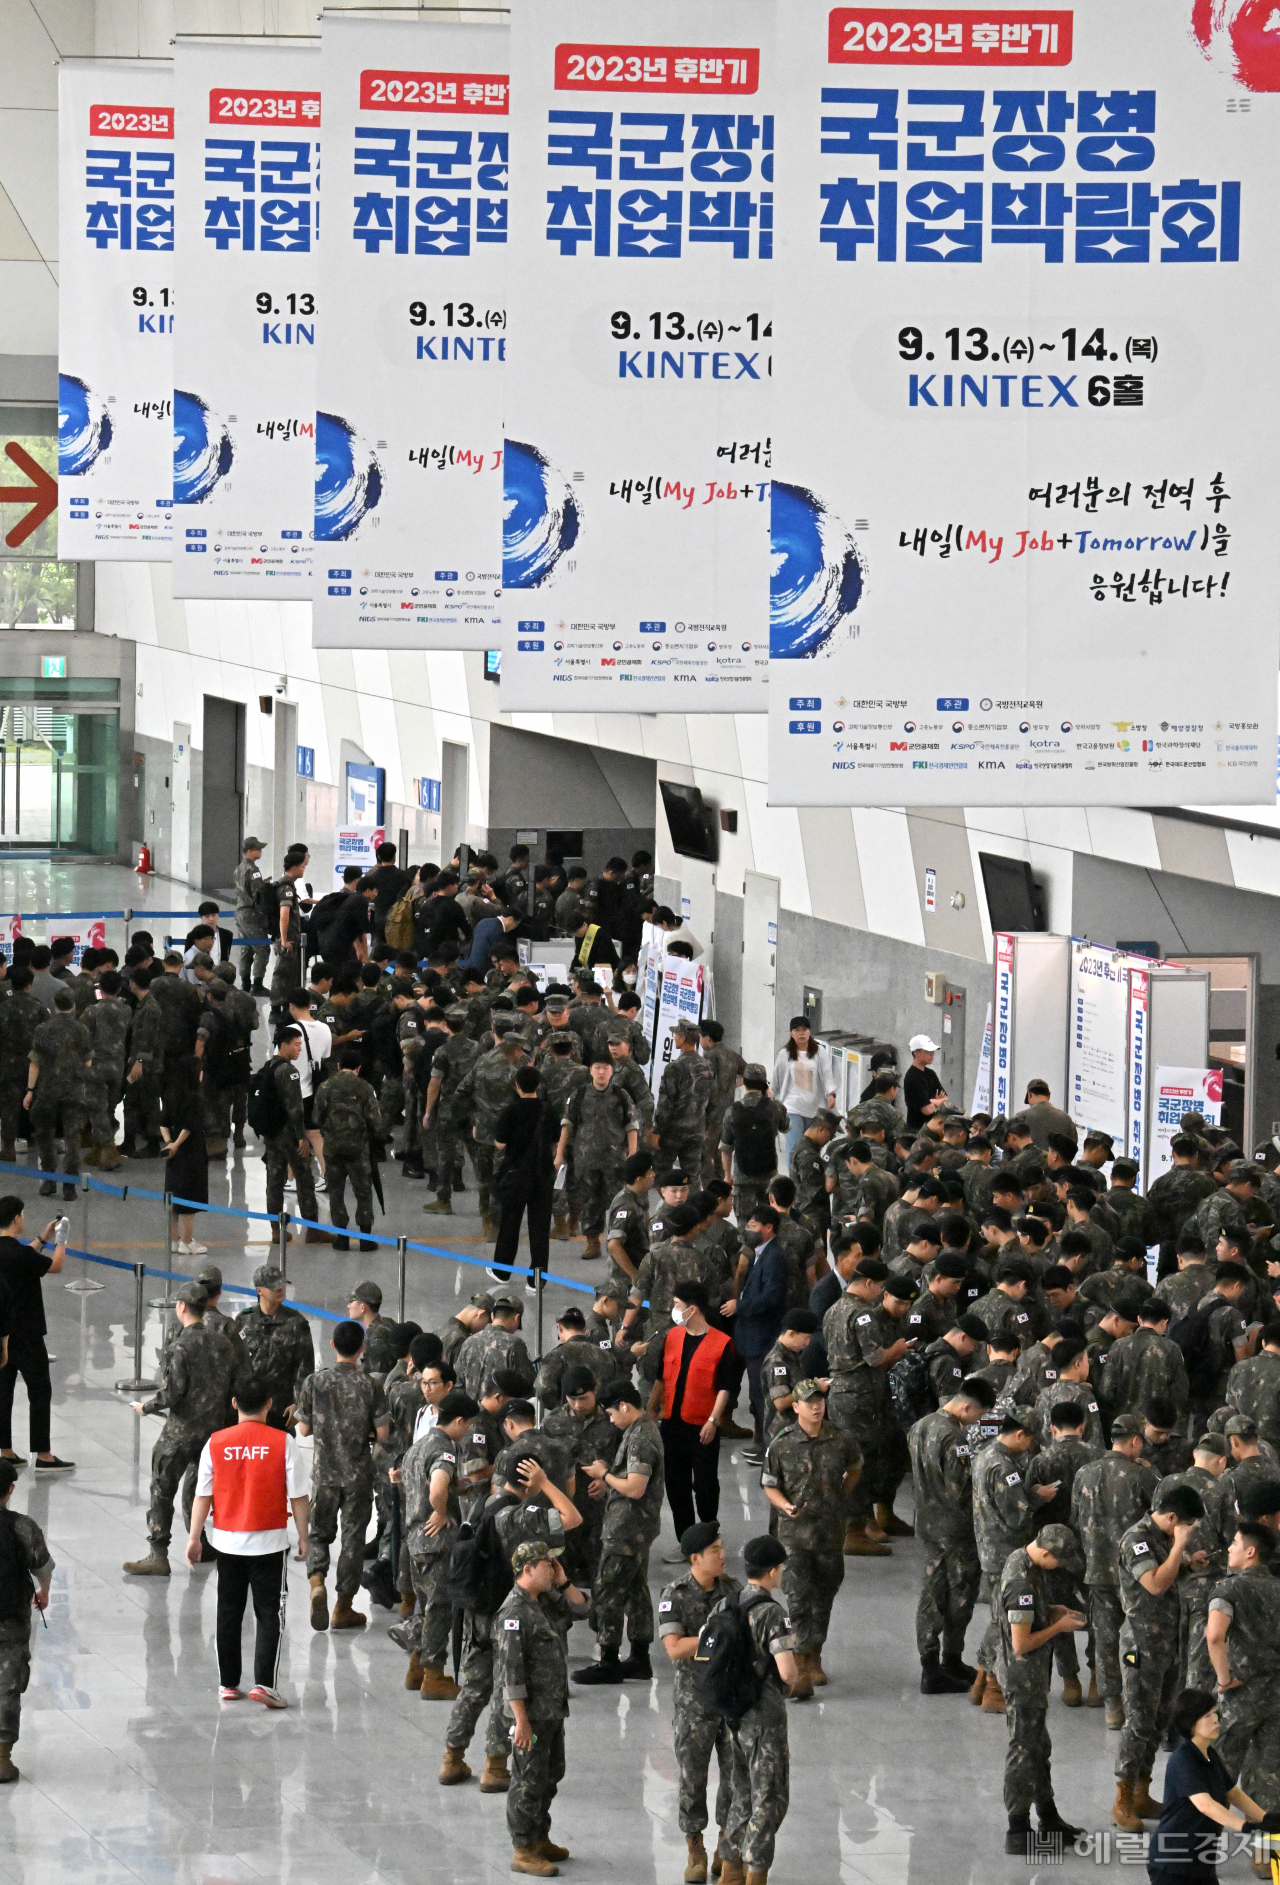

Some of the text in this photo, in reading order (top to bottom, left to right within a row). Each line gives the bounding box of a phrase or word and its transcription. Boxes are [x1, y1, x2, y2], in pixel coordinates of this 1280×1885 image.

[844, 22, 1058, 53] 2023년 후반기
[567, 55, 746, 83] 2023년 후반기
[371, 80, 509, 105] 2023년 후반
[99, 112, 168, 131] 2023년
[219, 97, 296, 118] 2023년
[821, 87, 1156, 172] 국군장병
[86, 150, 174, 199] 국군
[205, 139, 320, 194] 국군
[86, 201, 174, 251] 취업
[205, 196, 320, 252] 취업
[820, 178, 1241, 263] 취업박람회
[160, 288, 174, 307] 1
[263, 323, 314, 345] KIN
[619, 351, 760, 379] KINTEX
[909, 374, 1143, 407] KINTEX 6홀
[134, 400, 171, 420] 내일(
[257, 419, 313, 441] 내일(M
[409, 445, 504, 474] 내일(My J
[610, 476, 771, 509] 내일(My Job+T
[1029, 472, 1231, 513] 여러분의 전역 후
[899, 524, 1003, 563] 내일(My
[1090, 569, 1230, 606] 응원합니다!
[570, 623, 596, 631] 대한민국
[597, 623, 616, 631] 국방부
[645, 623, 660, 631] 주관
[796, 699, 1043, 710] 주최 대한민국 국방부 주관 국방전직교육원
[796, 722, 815, 732] 후원
[846, 742, 877, 750] 서울특별시
[1030, 740, 1060, 748] kotra
[832, 762, 856, 770] NIDS
[912, 761, 928, 769] FKI
[998, 972, 1009, 1068] 국군장병
[1159, 1098, 1204, 1113] 국군장병
[224, 1446, 269, 1460] STAFF
